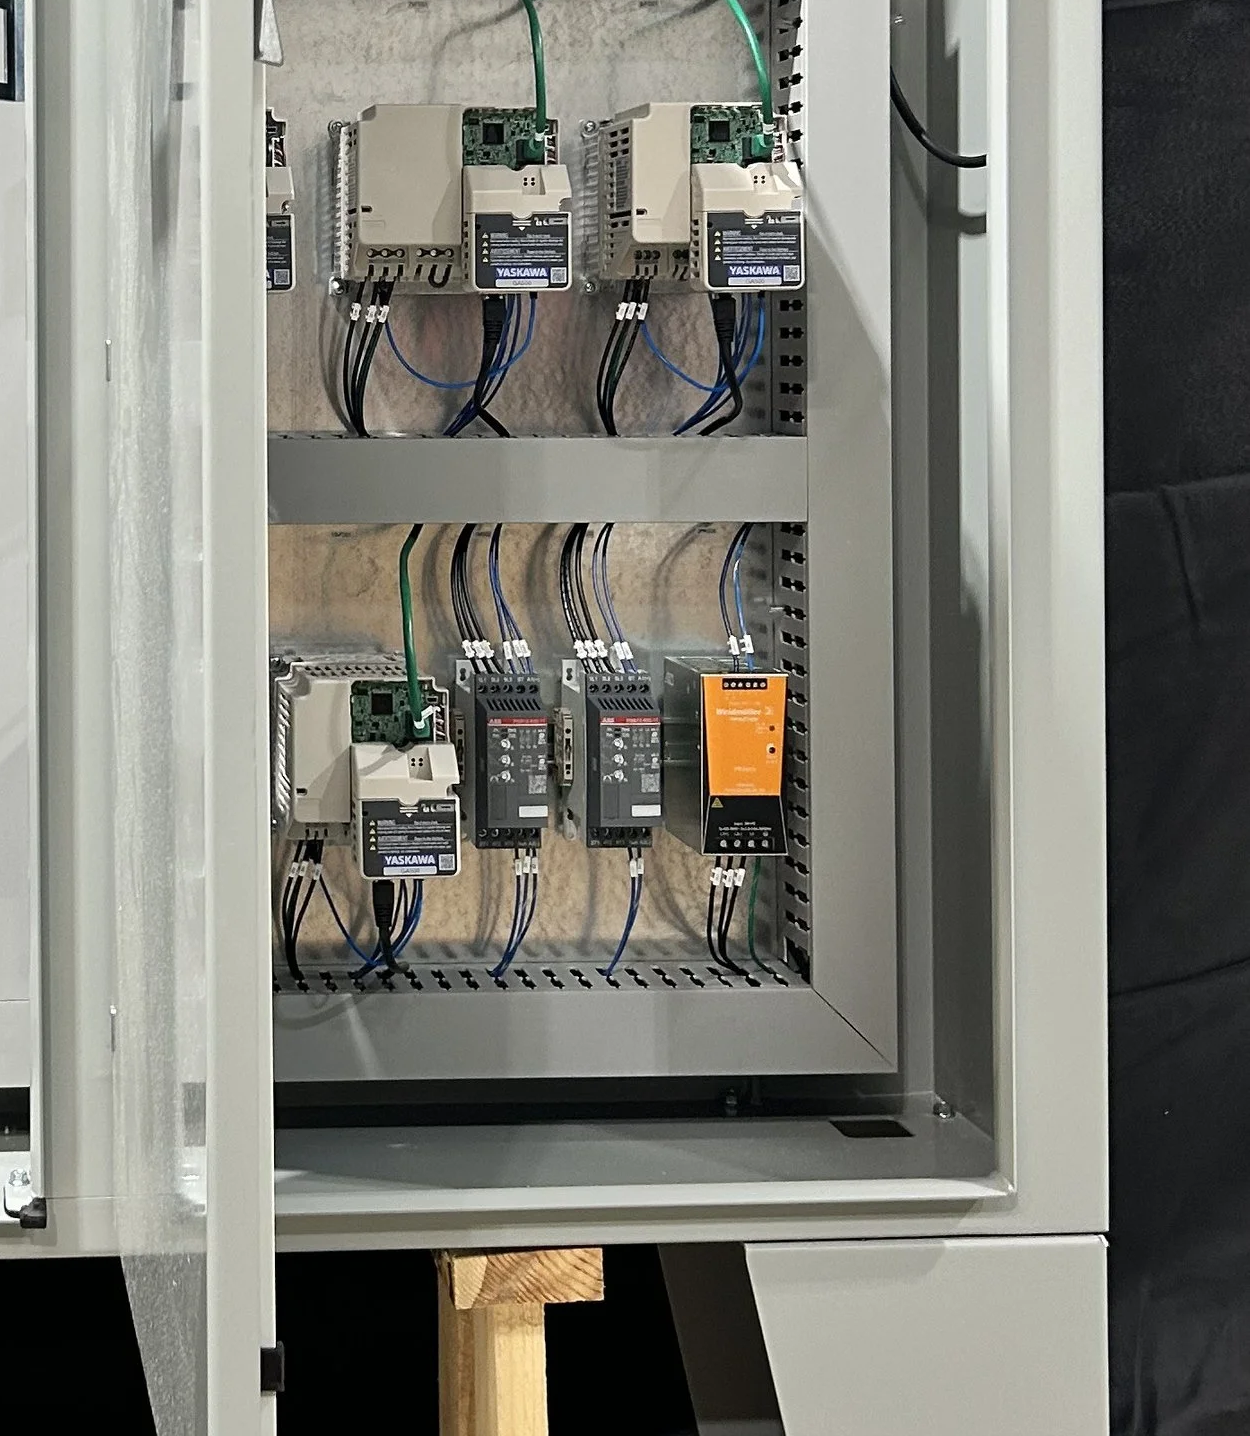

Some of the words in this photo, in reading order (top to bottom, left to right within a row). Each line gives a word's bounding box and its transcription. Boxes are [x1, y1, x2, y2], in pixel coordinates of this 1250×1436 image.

[496, 267, 548, 277] YASKAWA
[729, 266, 781, 275] YASKAWA
[385, 855, 435, 865] YASKAWA
